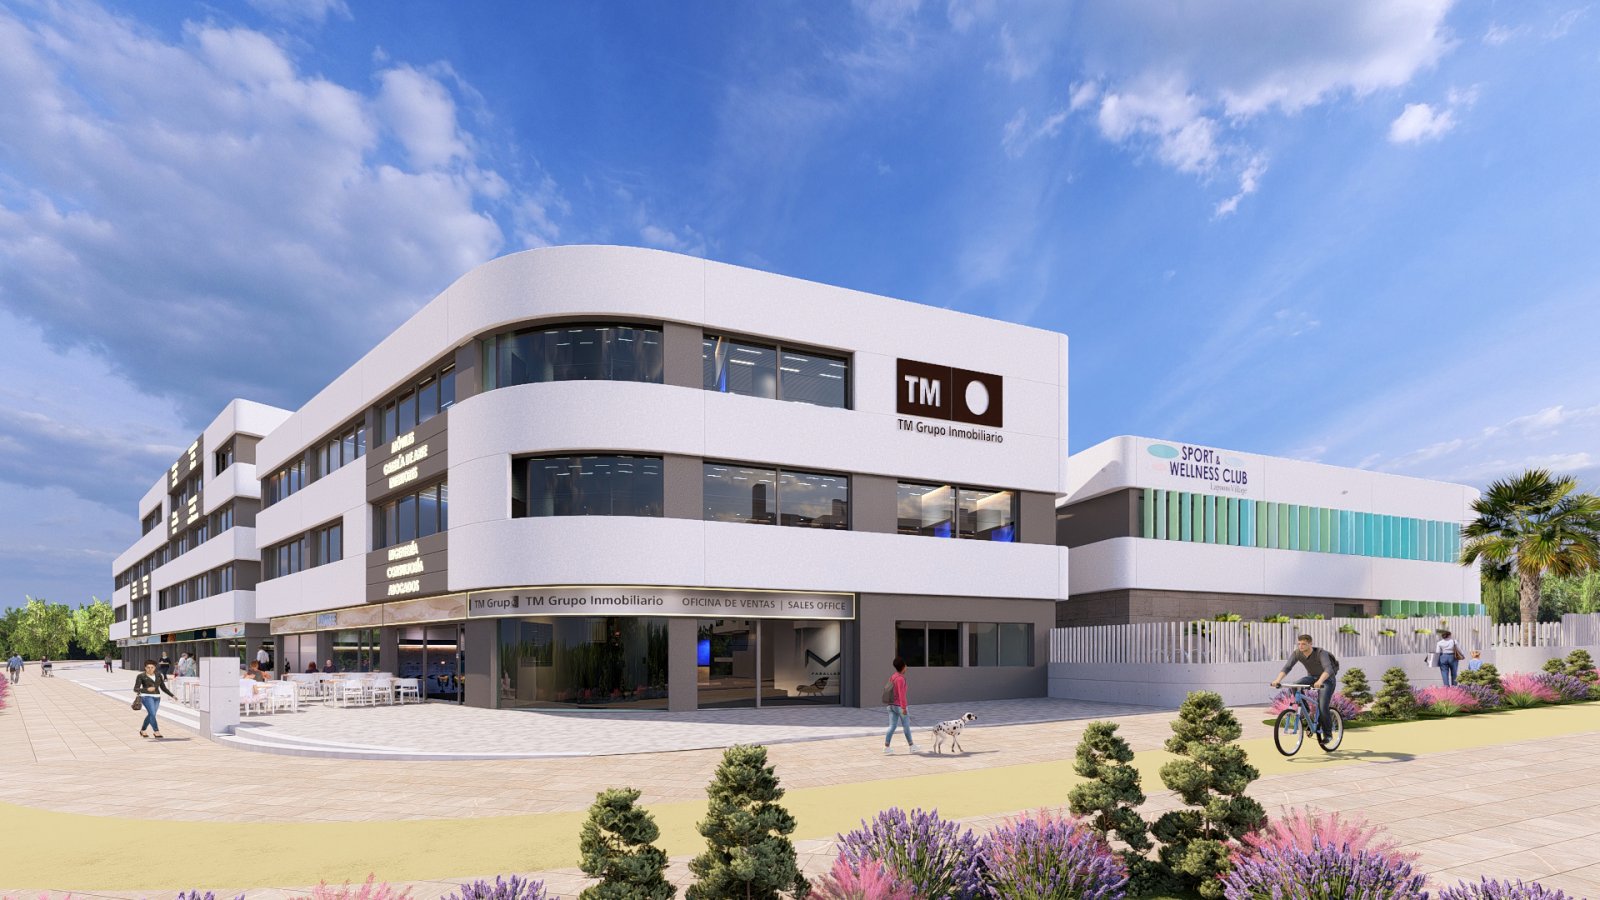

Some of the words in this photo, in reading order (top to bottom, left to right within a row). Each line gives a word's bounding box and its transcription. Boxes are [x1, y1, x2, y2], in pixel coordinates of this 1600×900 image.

[904, 374, 941, 407] TM
[897, 418, 913, 431] TM
[916, 421, 946, 437] Grupo
[948, 425, 1004, 443] Inmobiliario
[1182, 445, 1214, 465] SPORT
[1215, 455, 1221, 465] &
[1169, 461, 1220, 481] WELLNESS
[1222, 468, 1248, 485] CLUB
[474, 599, 485, 609] TM
[525, 596, 544, 606] TM
[548, 595, 587, 607] Grupo
[590, 595, 664, 606] Inmobiliario
[682, 597, 722, 608] OFICINA
[725, 599, 738, 608] DE
[740, 599, 776, 609] VENTAS
[788, 601, 814, 610] SALES
[816, 601, 847, 611] OFFICE
